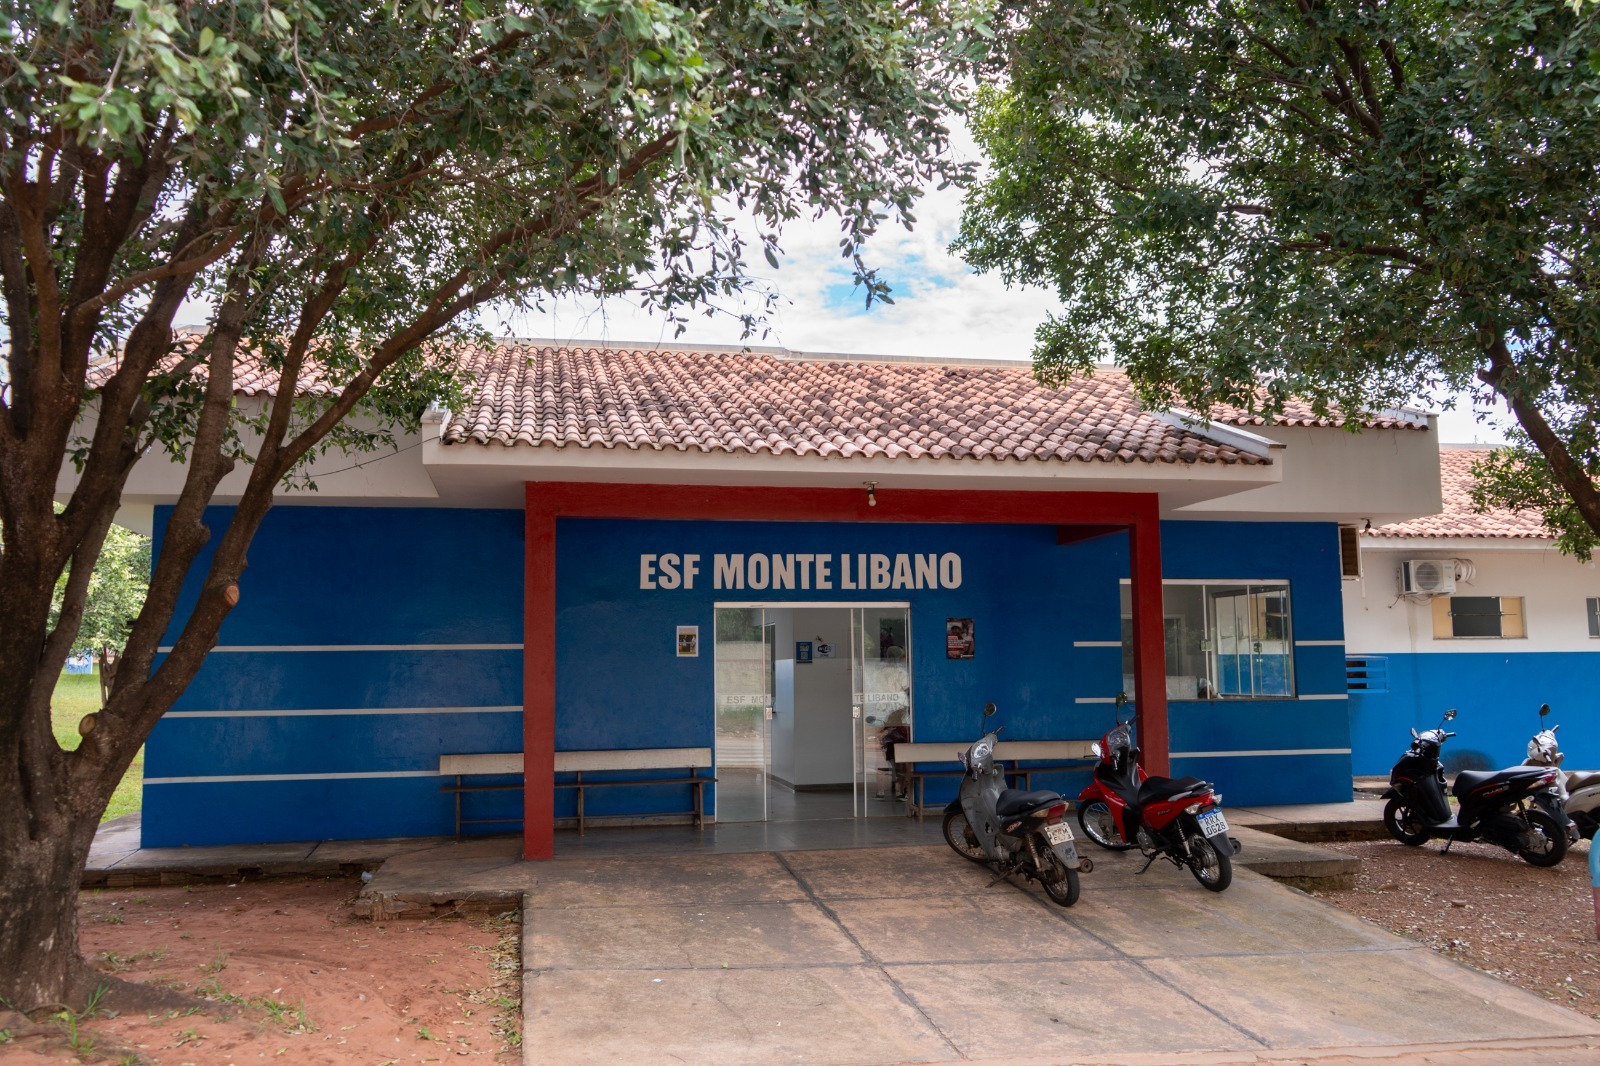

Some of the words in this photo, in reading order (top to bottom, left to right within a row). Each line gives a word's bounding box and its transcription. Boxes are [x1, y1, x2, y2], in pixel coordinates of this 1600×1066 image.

[639, 553, 701, 590] ESF
[713, 552, 832, 590] MONTE
[841, 552, 962, 590] LIBANO
[726, 695, 746, 704] ESF
[867, 693, 899, 702] LIBANO
[1203, 813, 1221, 827] RRX
